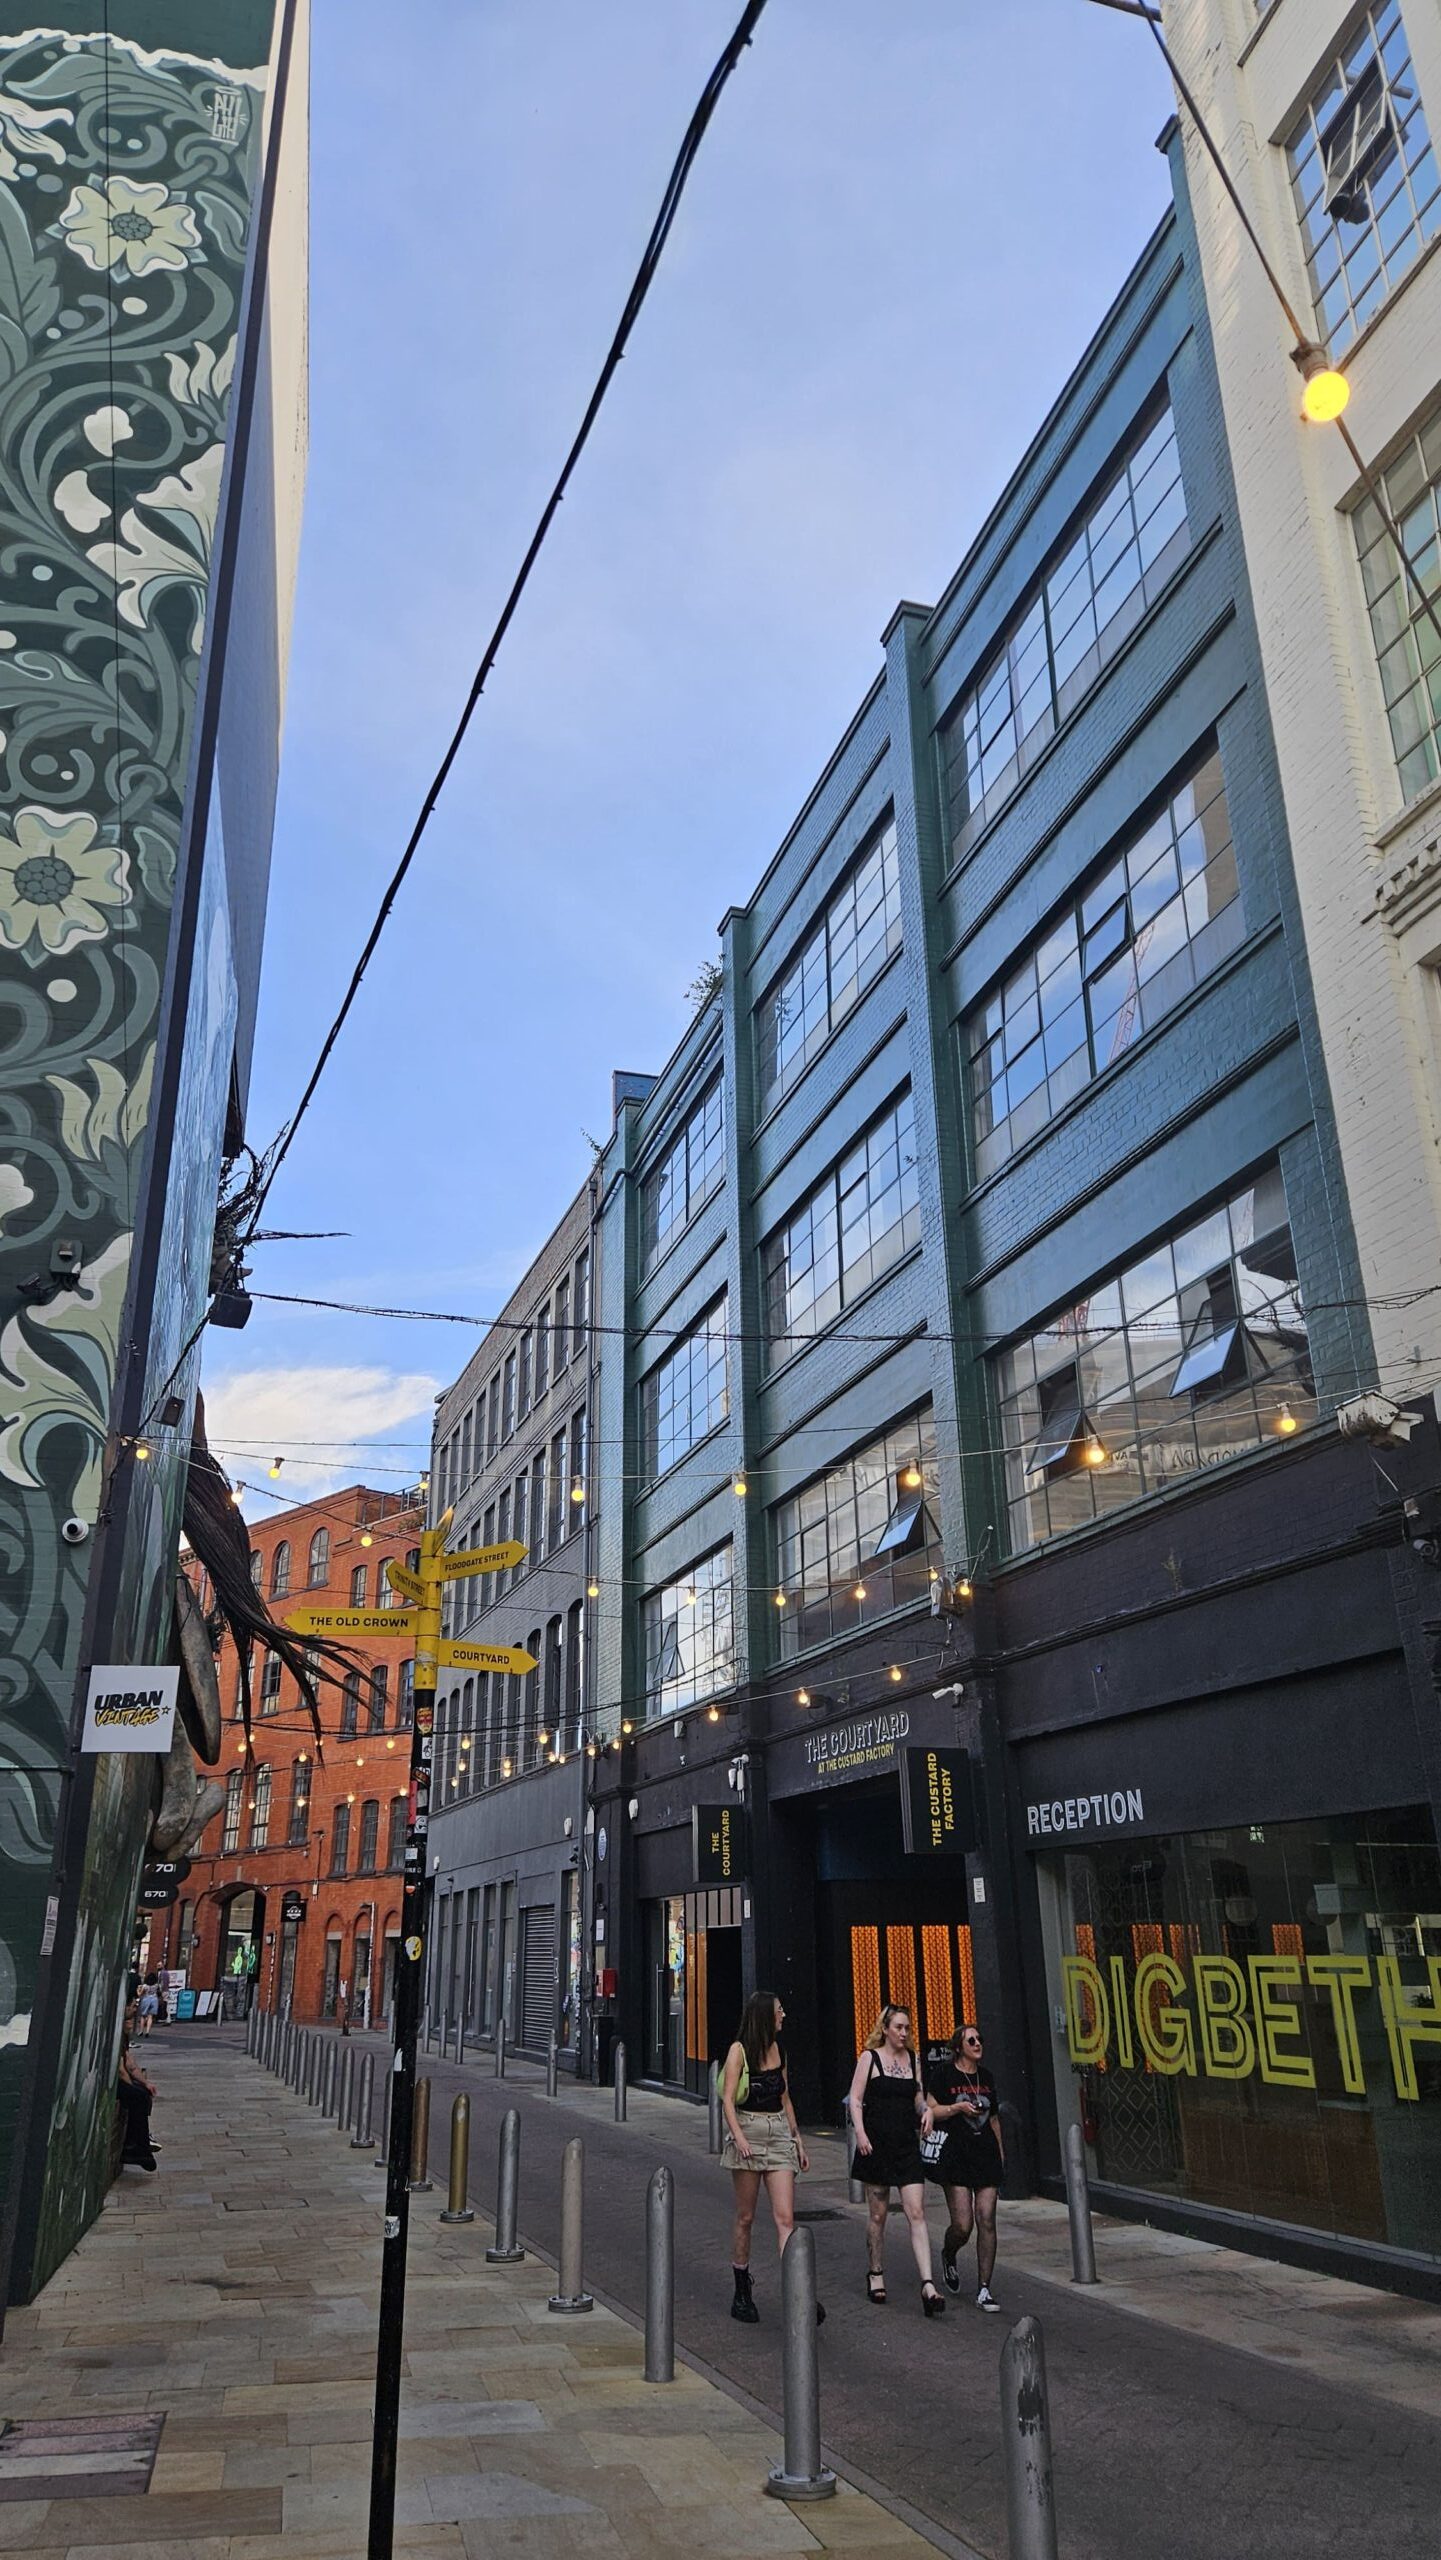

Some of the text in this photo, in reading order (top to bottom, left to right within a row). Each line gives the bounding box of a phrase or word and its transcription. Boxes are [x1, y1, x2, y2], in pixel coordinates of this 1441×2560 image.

[445, 1551, 509, 1572] FLOODGATE STREET
[410, 1580, 425, 1596] STREET
[309, 1616, 409, 1628] THE OLD CROWN
[452, 1649, 510, 1665] COURTYARD
[94, 1690, 164, 1711] URBAN
[95, 1706, 160, 1727] VINTAGE
[804, 1711, 910, 1763] THE COURTYARD
[817, 1743, 895, 1774] AT THE CUSTARD FACTORY
[927, 1752, 943, 1846] THE CUSTARD
[941, 1768, 955, 1830] FACTORY
[1027, 1788, 1144, 1835] RECEPTION
[711, 1832, 720, 1854] THE
[722, 1810, 731, 1876] COURTYARD
[1062, 1952, 1441, 2100] DIGBETH
